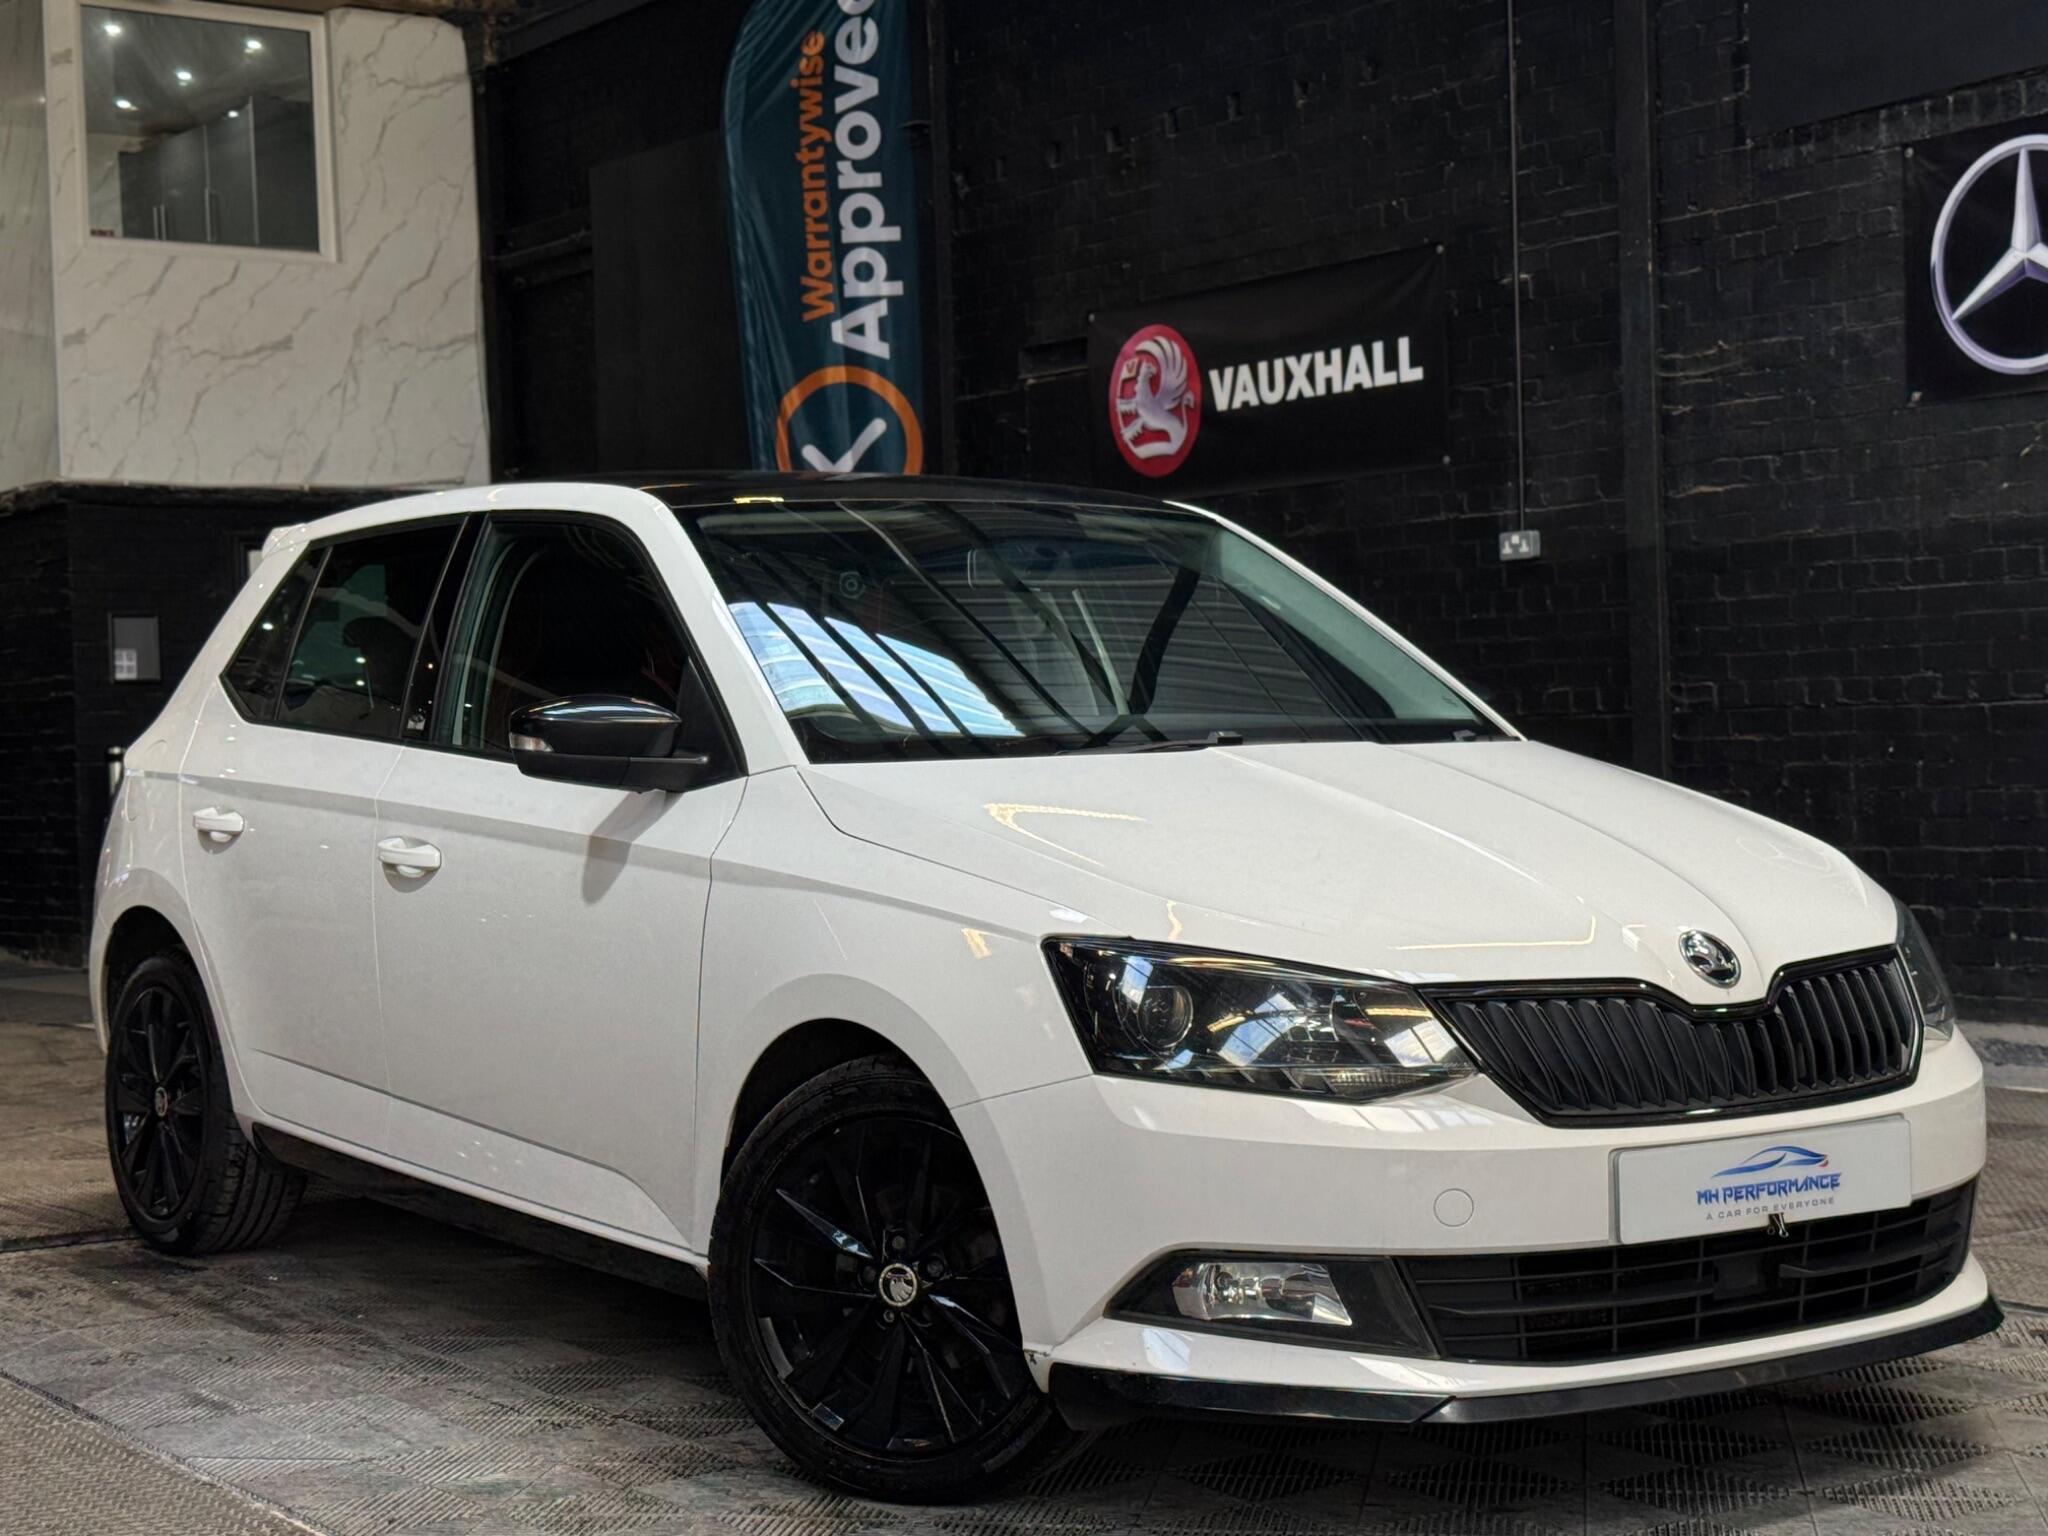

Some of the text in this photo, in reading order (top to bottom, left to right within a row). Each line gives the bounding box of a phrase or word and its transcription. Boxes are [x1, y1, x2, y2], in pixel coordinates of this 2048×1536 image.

[790, 31, 836, 322] Warrantywise
[1209, 336, 1424, 412] VAUXHALL
[1696, 1173, 1842, 1206] MH PERFORMANCE
[1706, 1197, 1835, 1221] A CAR FOR EVERYONE
